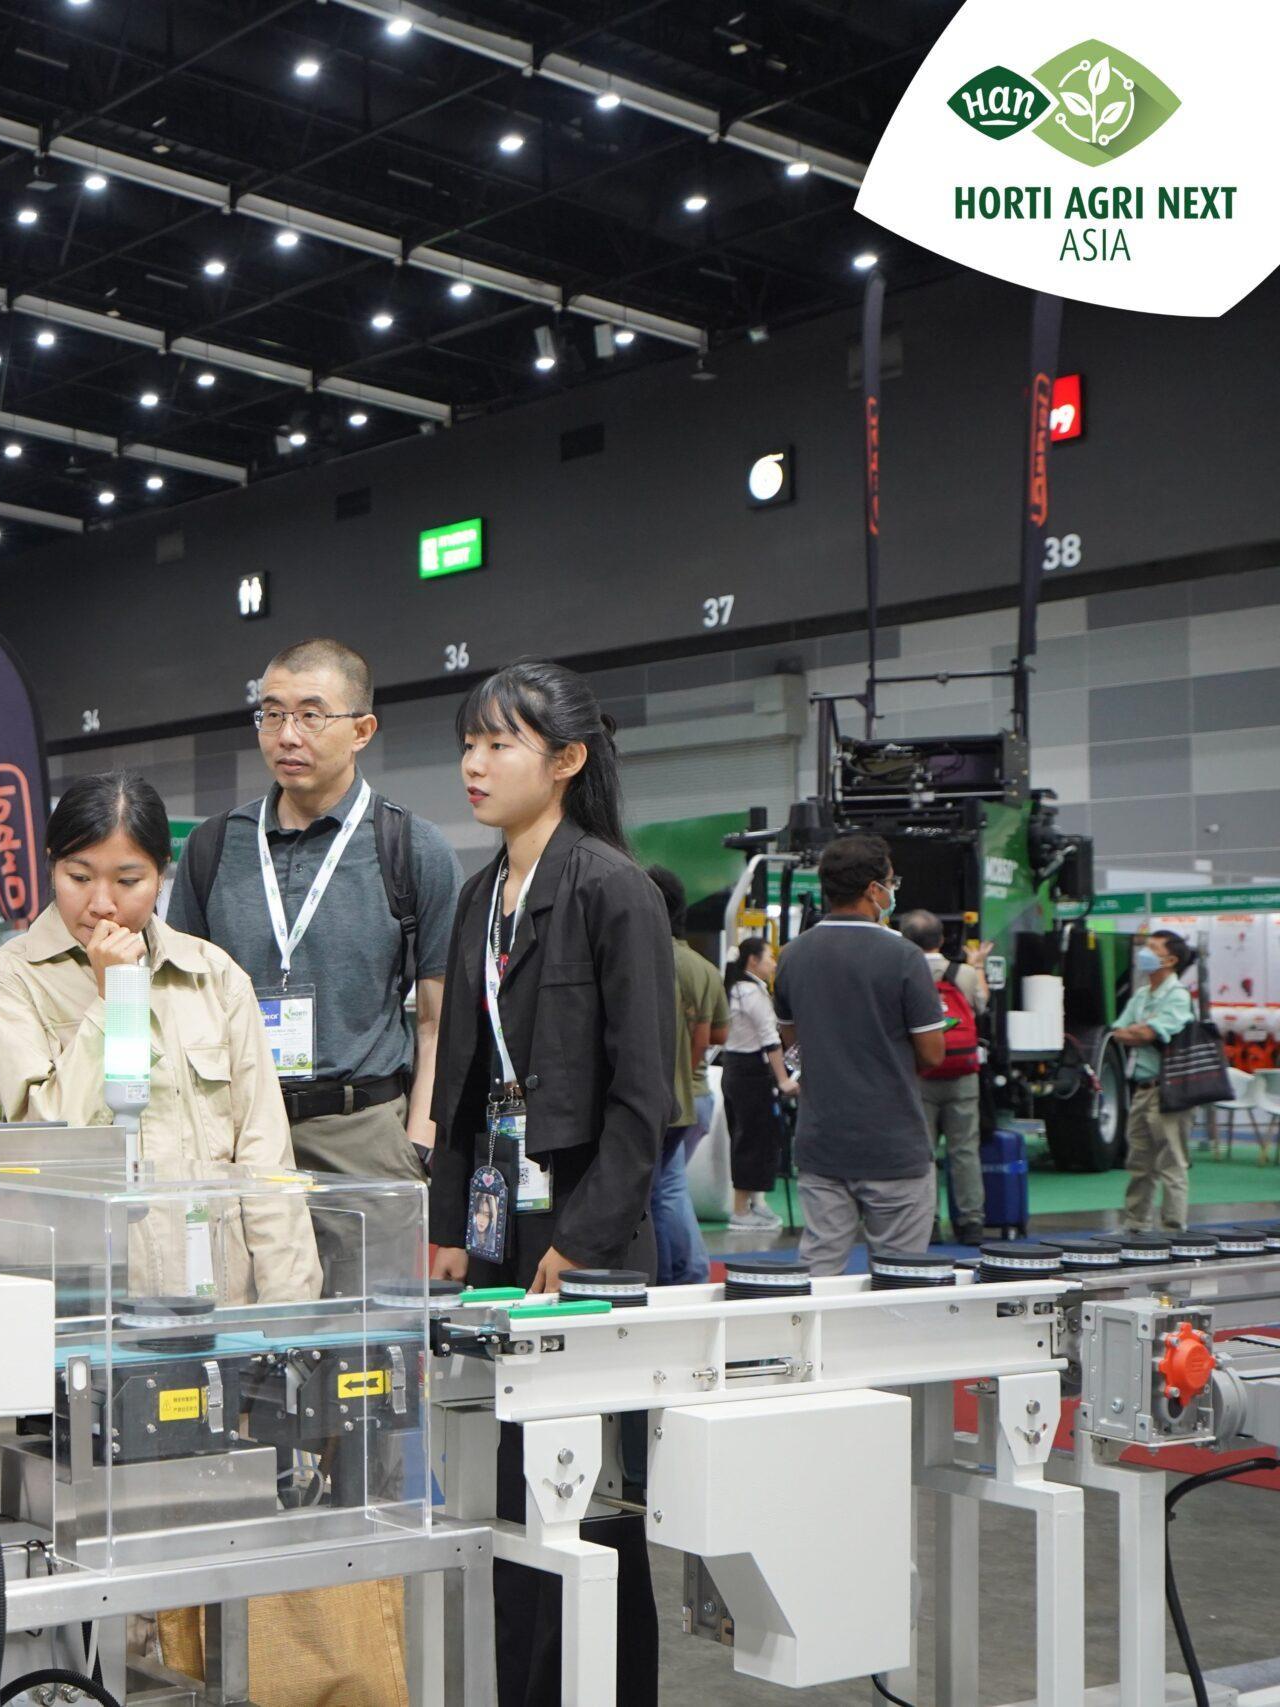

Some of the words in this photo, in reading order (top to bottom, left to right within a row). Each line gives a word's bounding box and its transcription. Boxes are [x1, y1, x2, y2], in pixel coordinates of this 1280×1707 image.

[1042, 534, 1082, 571] 38
[703, 594, 735, 628] 37
[444, 642, 470, 671] 36
[82, 709, 101, 732] 34
